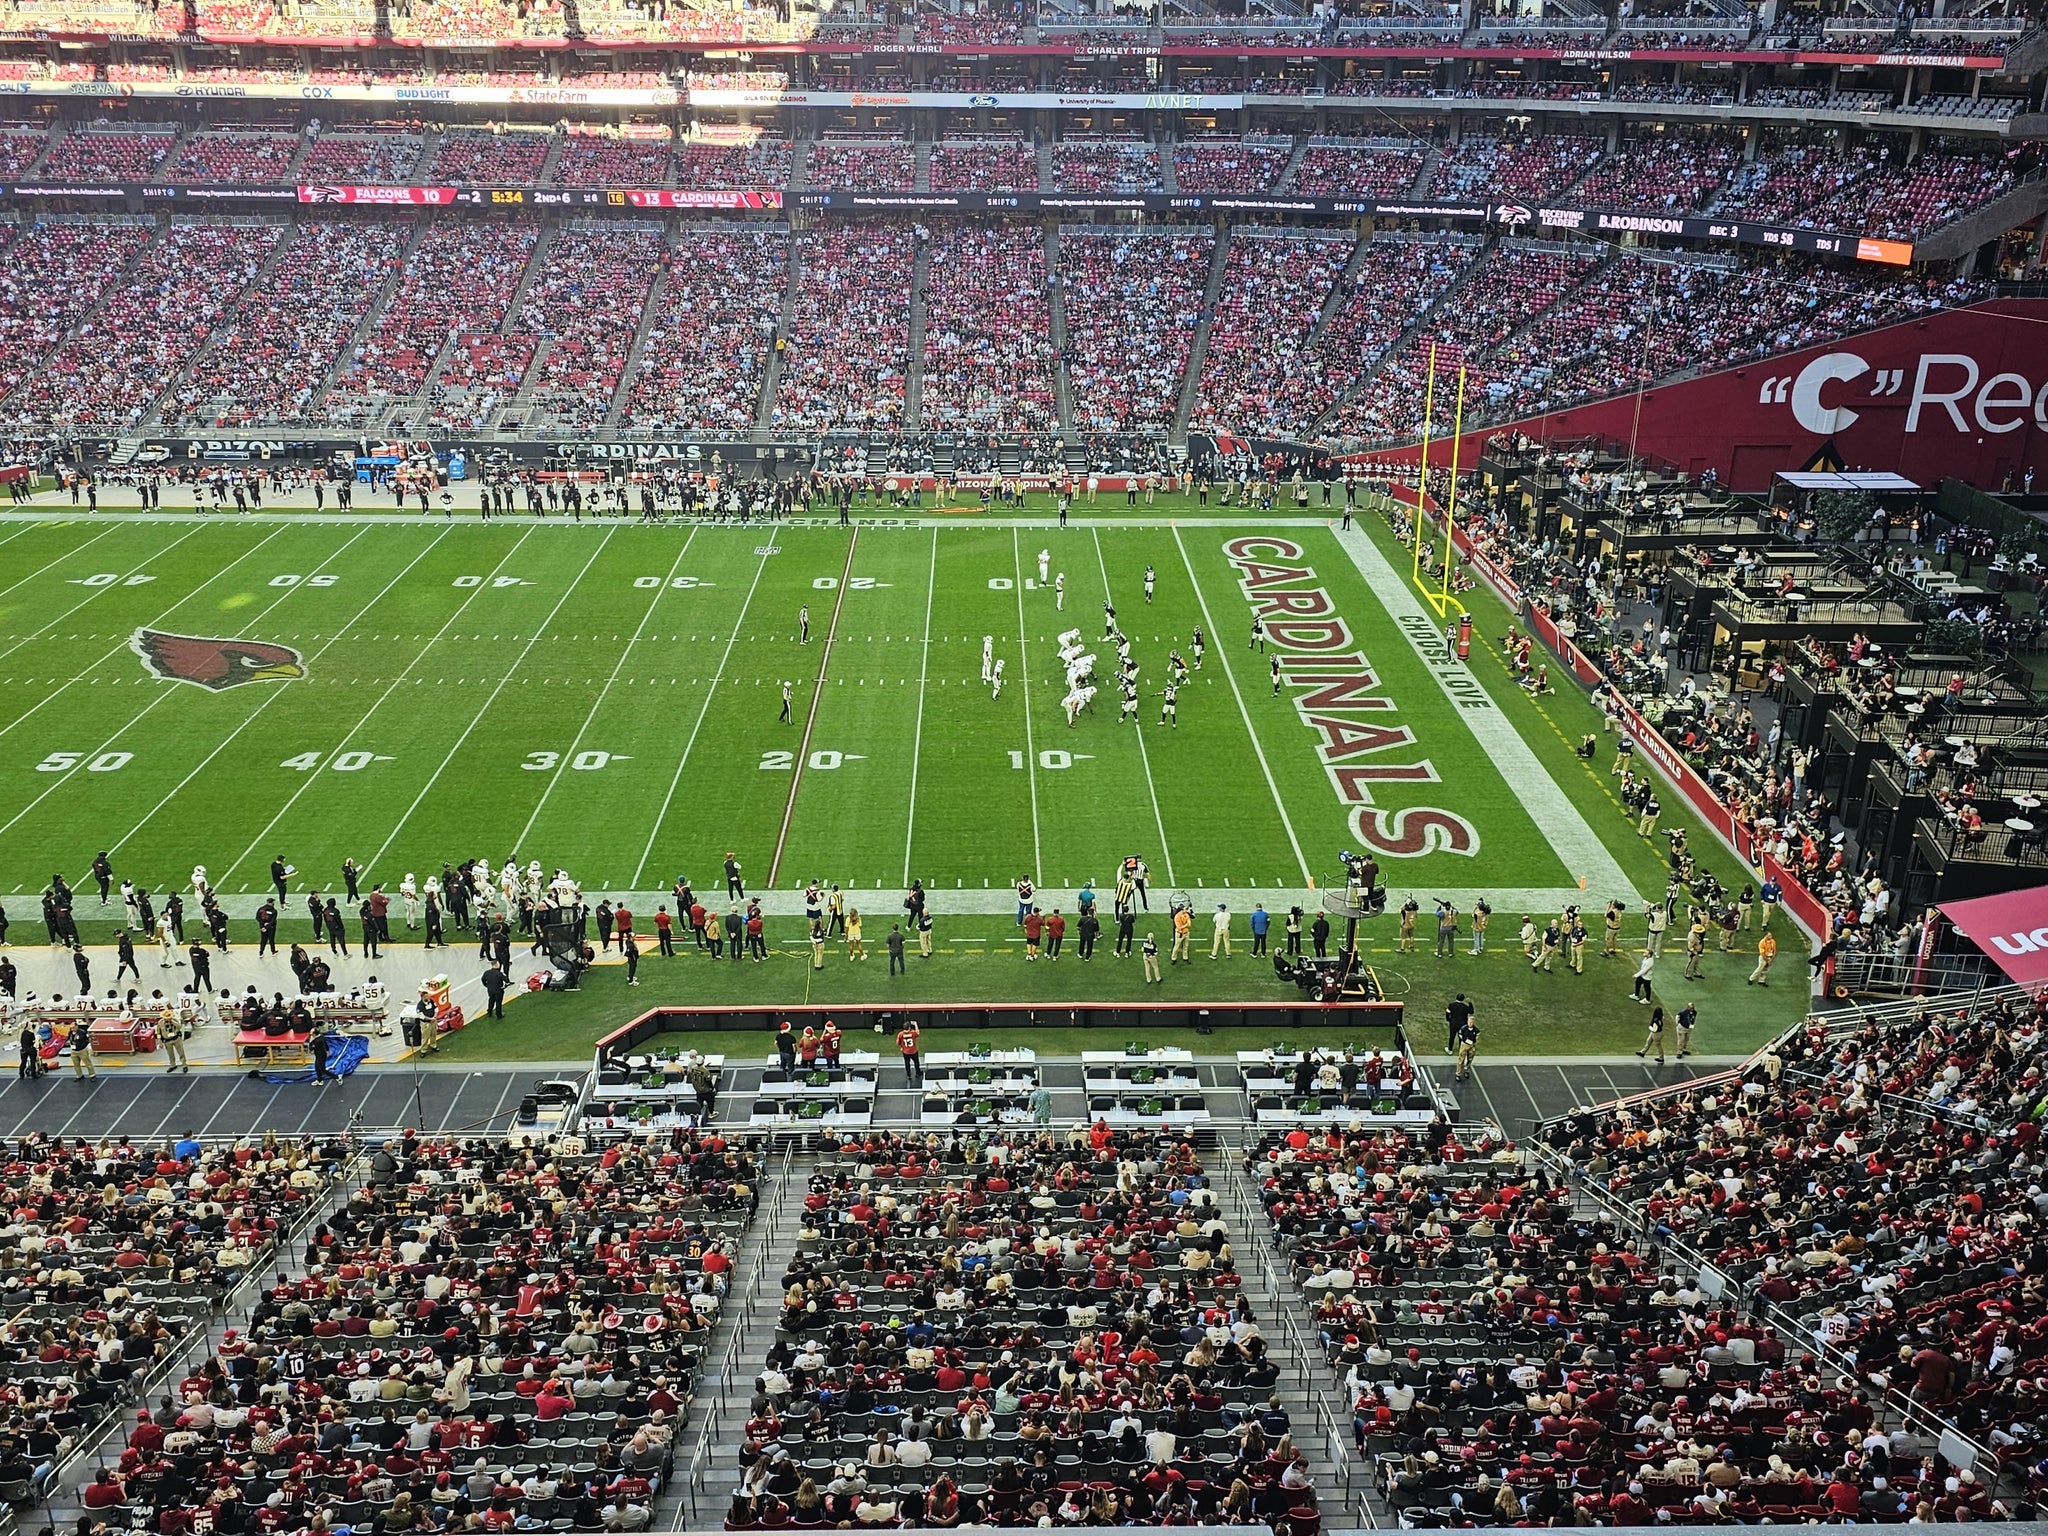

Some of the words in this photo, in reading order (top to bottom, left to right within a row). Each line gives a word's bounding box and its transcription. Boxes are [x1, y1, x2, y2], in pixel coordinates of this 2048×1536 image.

[862, 44, 872, 52] 22
[874, 44, 904, 53] ROGER
[906, 45, 942, 53] WEHRLI
[1074, 46, 1085, 54] 62
[1086, 46, 1129, 55] CHARLEY
[1132, 46, 1160, 55] TRIPPI
[1552, 50, 1562, 58] 24
[1563, 50, 1596, 59] ADRIAN
[1596, 50, 1632, 60] WILSON
[1876, 54, 1905, 66] JIMMY
[1906, 56, 1965, 66] CONZELMAN
[69, 84, 119, 94] SAFEWAY
[195, 87, 247, 96] HYUNDAI
[302, 87, 333, 98] COX
[396, 89, 419, 98] BUD
[420, 89, 451, 98] LIGHT
[973, 96, 994, 106] Ford
[1145, 95, 1203, 109] AVNET
[356, 189, 410, 200] FALCONS
[422, 190, 440, 202] 10
[472, 190, 482, 202] 2
[492, 191, 524, 203] 5:34
[609, 193, 623, 204] 16
[644, 193, 660, 205] 13
[672, 193, 738, 204] CARDINALS
[1461, 208, 1485, 216] Cardinals
[1538, 208, 1584, 220] RECEIVING
[1541, 217, 1580, 228] LEADERS
[1598, 214, 1684, 234] B.ROBINSON
[1708, 226, 1728, 236] REC
[1730, 226, 1739, 238] 3
[1763, 232, 1780, 244] YDS
[1780, 233, 1794, 246] 58
[1816, 240, 1832, 250] TDS
[1834, 239, 1840, 252] 1
[1904, 354, 2048, 434] Re
[1398, 614, 1458, 668] CHOOSE
[1440, 665, 1492, 710] LOVE
[1222, 536, 1481, 858] CARDINALS
[758, 750, 844, 770] 20
[1008, 750, 1073, 770] 10
[1639, 728, 1682, 780] CARDINALS
[34, 752, 135, 772] 50
[279, 752, 374, 772] 40
[520, 751, 611, 772] 30
[1126, 857, 1138, 870] 2
[556, 886, 568, 896] 78
[1922, 930, 1936, 960] verizon
[365, 988, 378, 1000] 55
[76, 1001, 88, 1011] 47
[180, 998, 190, 1009] 10
[903, 1038, 914, 1048] 13
[564, 1144, 579, 1156] 56
[1558, 1194, 1569, 1206] 99
[688, 1246, 701, 1258] 30
[1352, 1304, 1363, 1316] 85
[1430, 1316, 1437, 1325] 3
[1828, 1322, 1845, 1335] 85
[650, 1340, 666, 1352] 35
[290, 1358, 304, 1374] 10
[1525, 1379, 1534, 1388] 11
[1801, 1416, 1821, 1424] DOCKETT
[470, 1434, 480, 1448] 6
[426, 1465, 436, 1474] 11
[1556, 1479, 1567, 1489] 10
[285, 1492, 293, 1502] 11
[131, 1506, 154, 1518] FEAR
[132, 1518, 146, 1529] NO
[194, 1518, 214, 1535] 85
